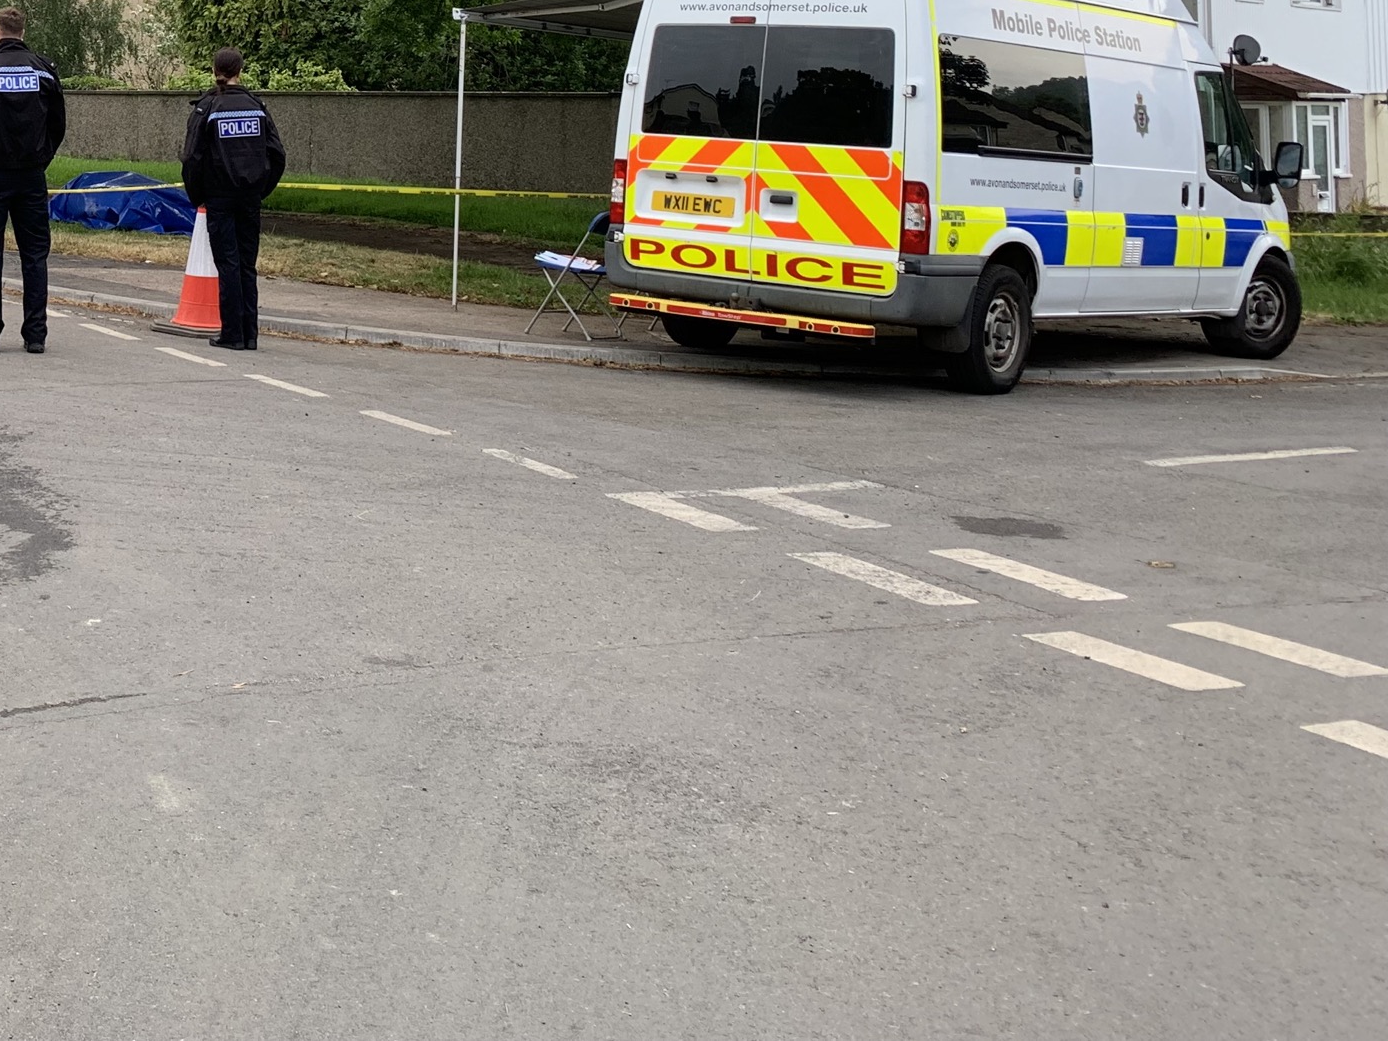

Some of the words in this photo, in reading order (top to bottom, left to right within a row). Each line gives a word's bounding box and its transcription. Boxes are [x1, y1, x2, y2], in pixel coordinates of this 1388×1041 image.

[679, 1, 868, 15] www.avonandsomerset.police.uk
[991, 8, 1043, 38] Mobile
[1046, 16, 1091, 44] Police
[1094, 25, 1142, 53] Station
[221, 120, 259, 136] POLICE
[970, 178, 1066, 192] www.avonandsomerset.police.uk
[663, 194, 690, 211] WX11
[692, 196, 722, 214] EWC
[629, 238, 886, 290] POLICE
